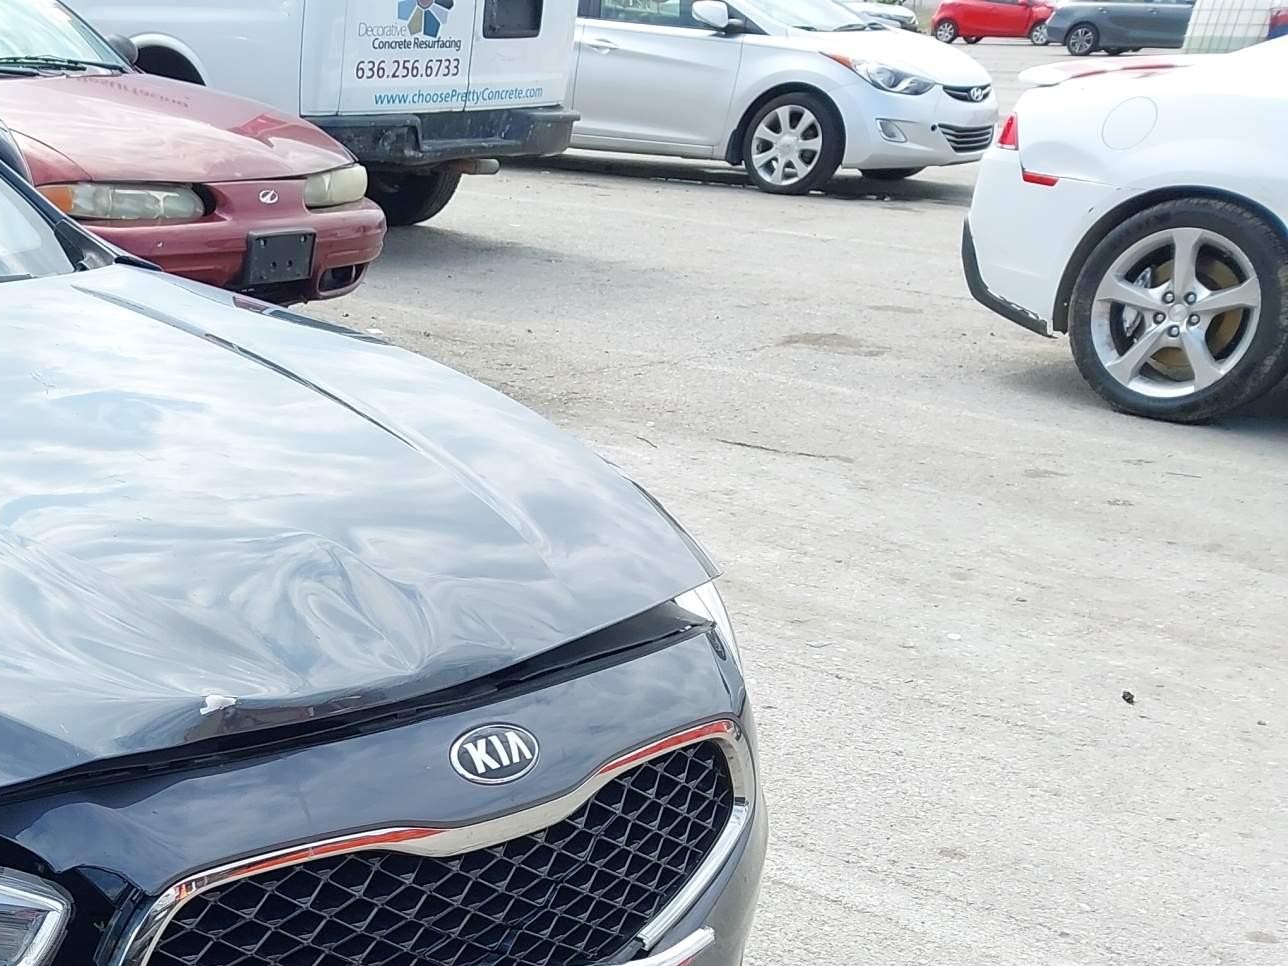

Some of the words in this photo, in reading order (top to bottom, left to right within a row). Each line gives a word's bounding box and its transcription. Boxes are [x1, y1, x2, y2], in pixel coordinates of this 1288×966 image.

[358, 22, 407, 37] Decorative
[372, 38, 412, 50] Concrete
[413, 37, 462, 52] Resurfacing
[355, 58, 460, 79] 636.256.6733
[374, 87, 543, 105] www.choosePrettyConcrete.com
[463, 731, 533, 774] KIA
